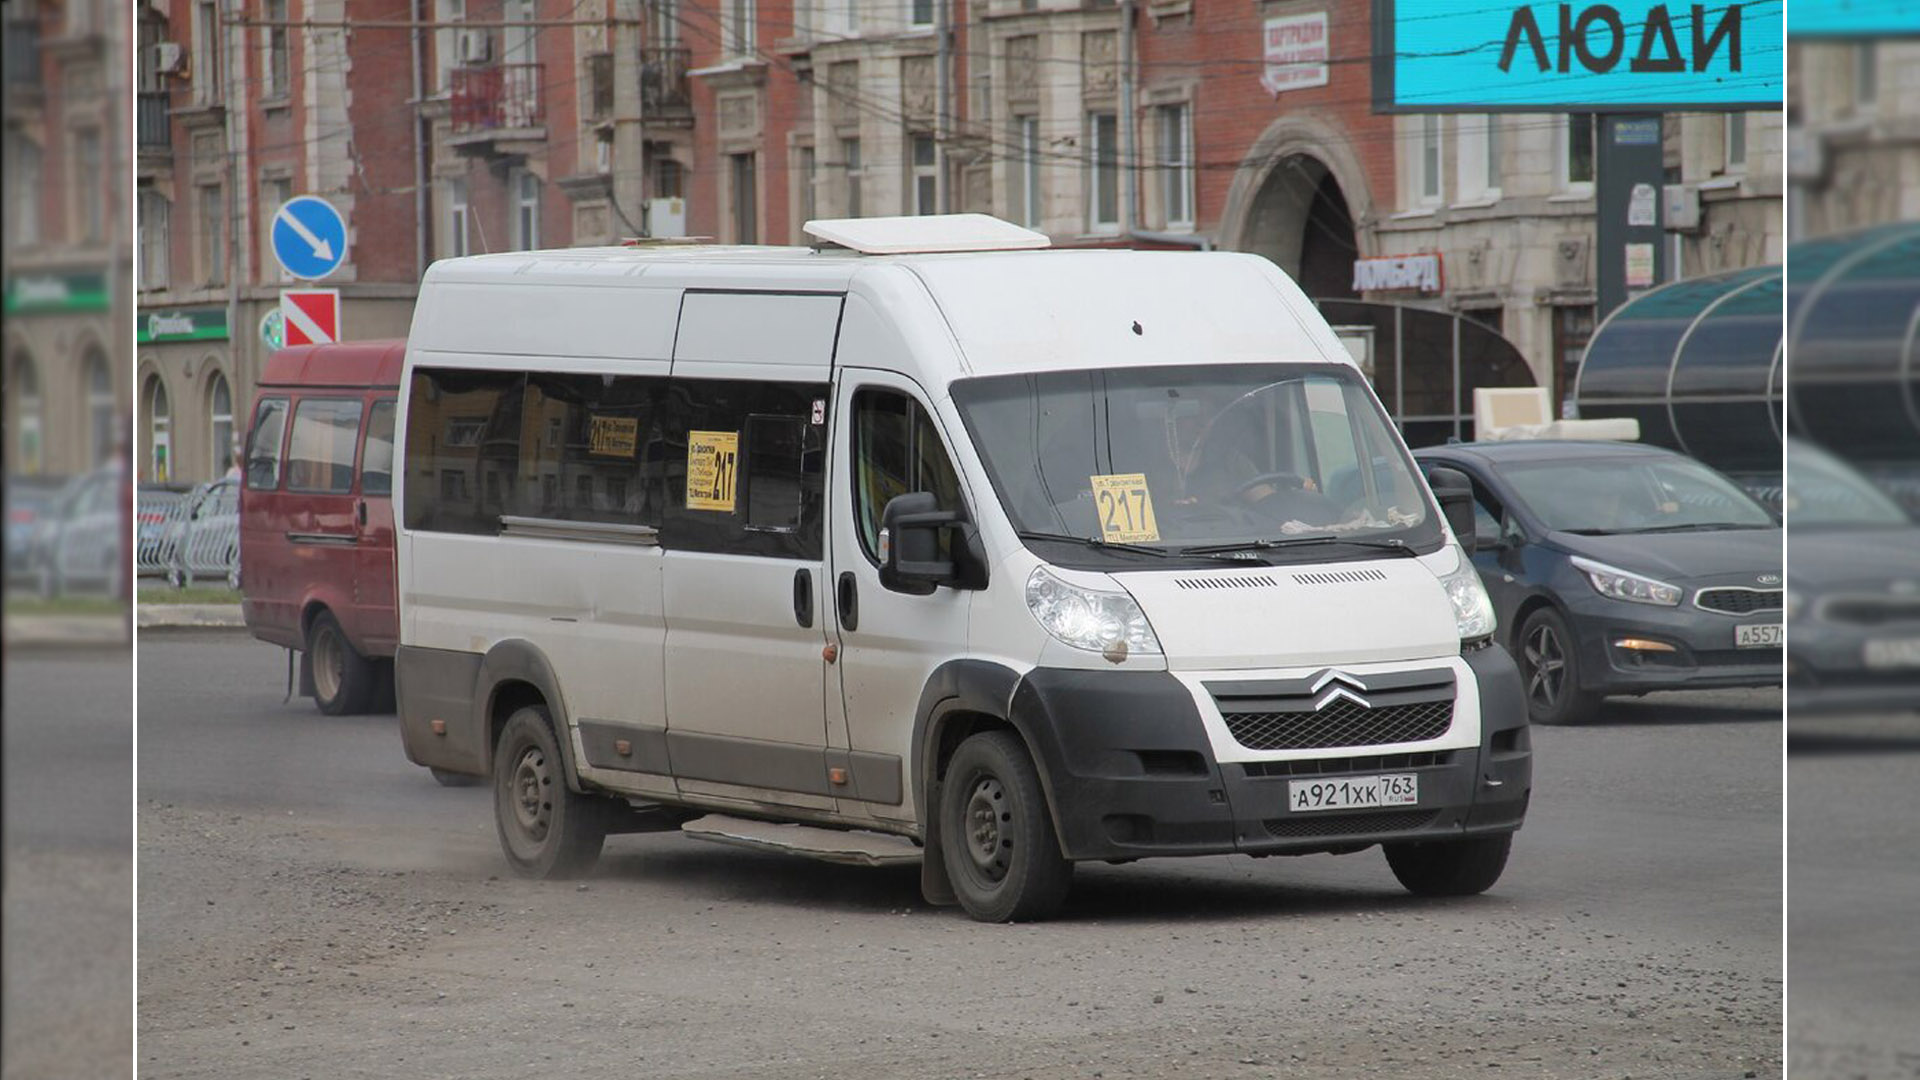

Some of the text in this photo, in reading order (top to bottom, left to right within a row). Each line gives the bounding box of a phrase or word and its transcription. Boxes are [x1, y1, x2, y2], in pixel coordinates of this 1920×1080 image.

[1497, 3, 1742, 74] ЛЮДИ
[1353, 257, 1440, 292] ЛОМБАРД
[713, 450, 734, 500] 217
[1100, 489, 1146, 531] 217
[1742, 625, 1783, 644] А557
